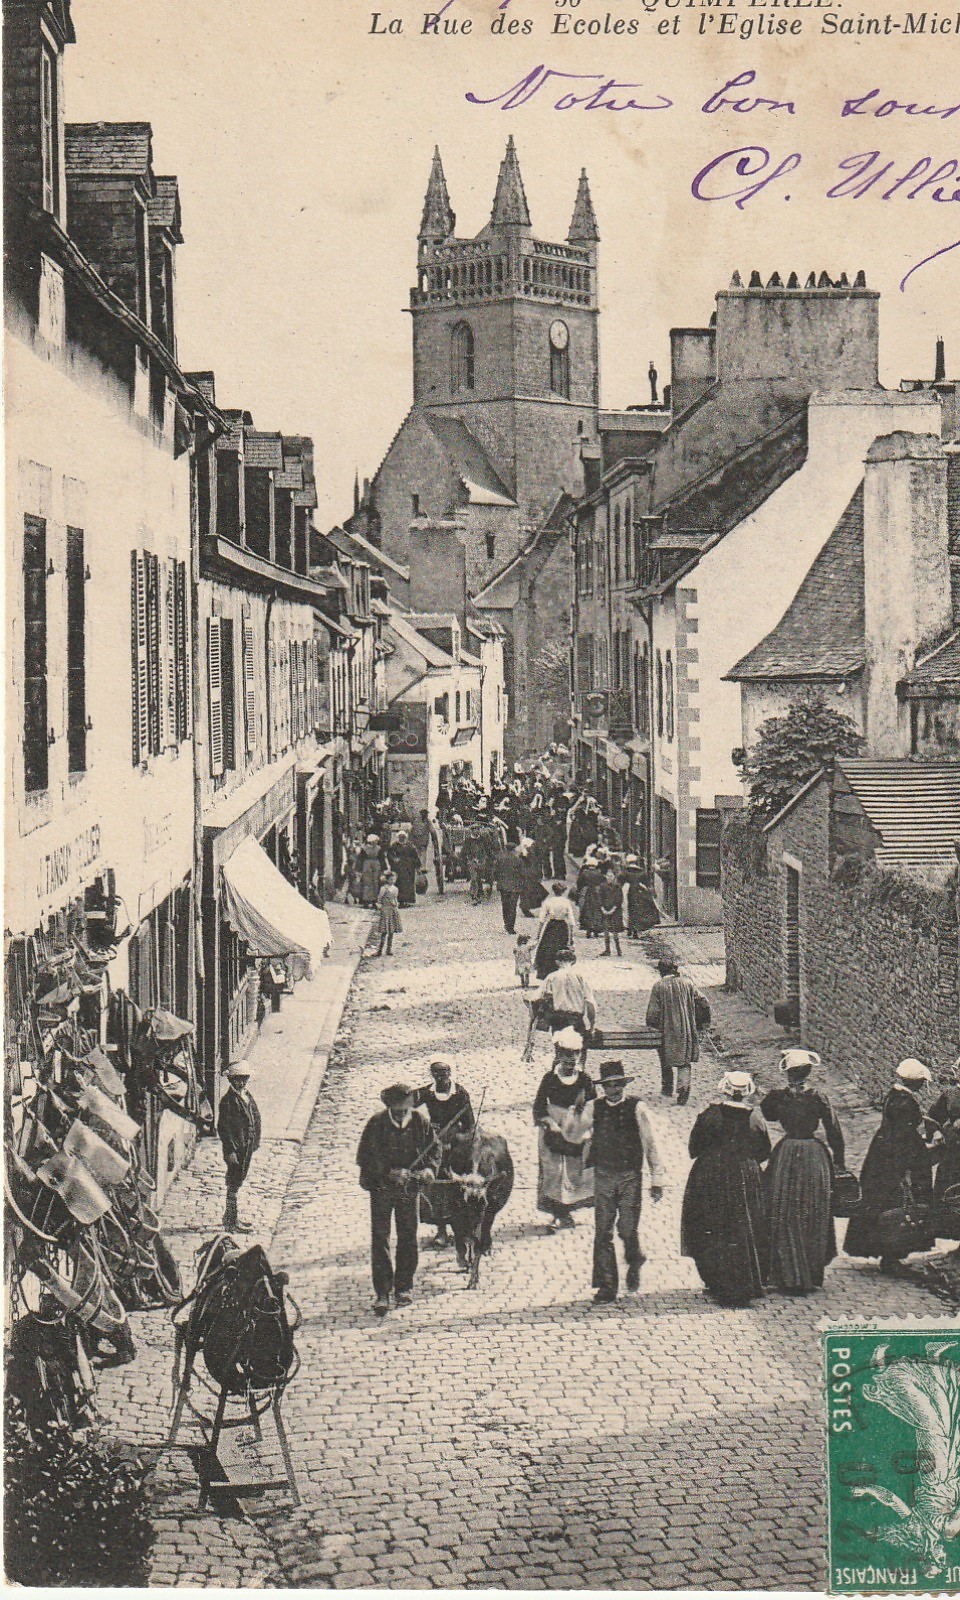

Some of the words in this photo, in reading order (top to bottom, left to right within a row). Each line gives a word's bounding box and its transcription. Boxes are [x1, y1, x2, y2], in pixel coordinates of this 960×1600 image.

[701, 69, 796, 114] bon
[831, 1346, 853, 1433] POSTES
[835, 1564, 918, 1585] FRANÇAISE
